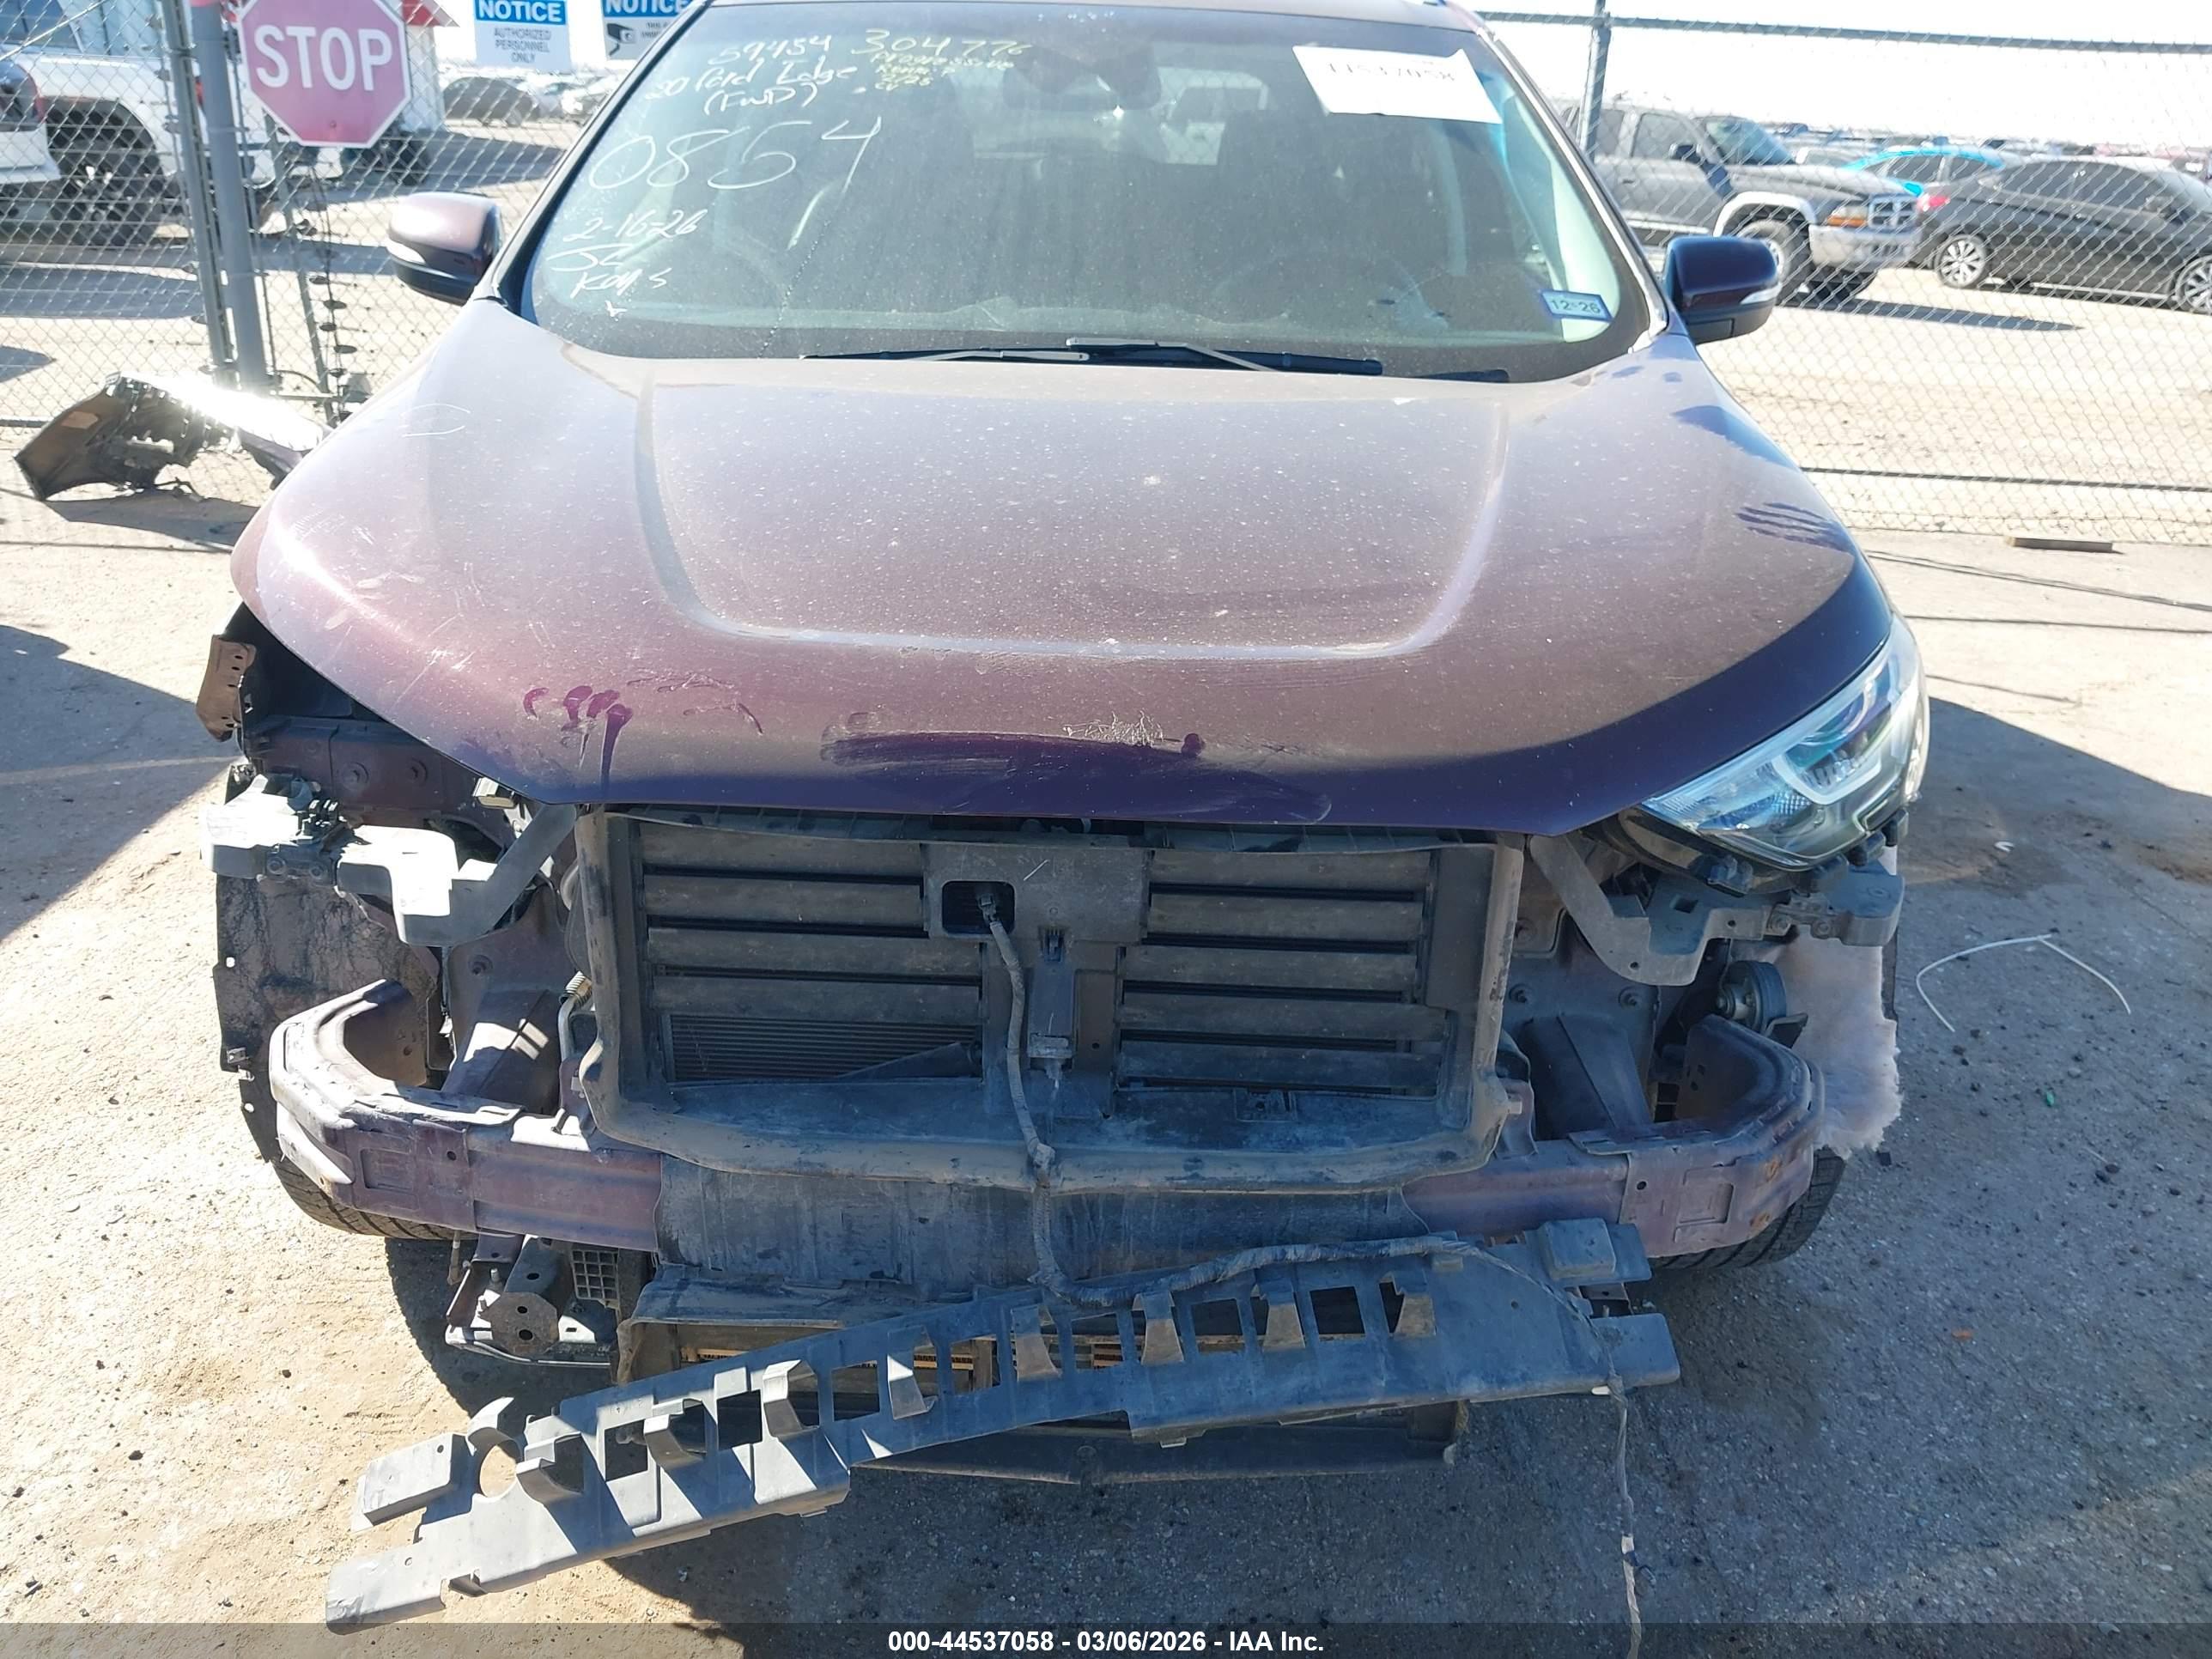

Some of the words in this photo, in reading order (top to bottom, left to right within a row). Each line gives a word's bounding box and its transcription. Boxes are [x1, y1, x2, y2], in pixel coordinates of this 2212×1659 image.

[477, 0, 562, 22] NOTICE
[495, 27, 551, 40] AUTHORIZED
[495, 40, 550, 52] PERSONNEL
[254, 25, 393, 91] STOP
[511, 52, 536, 64] ONLY
